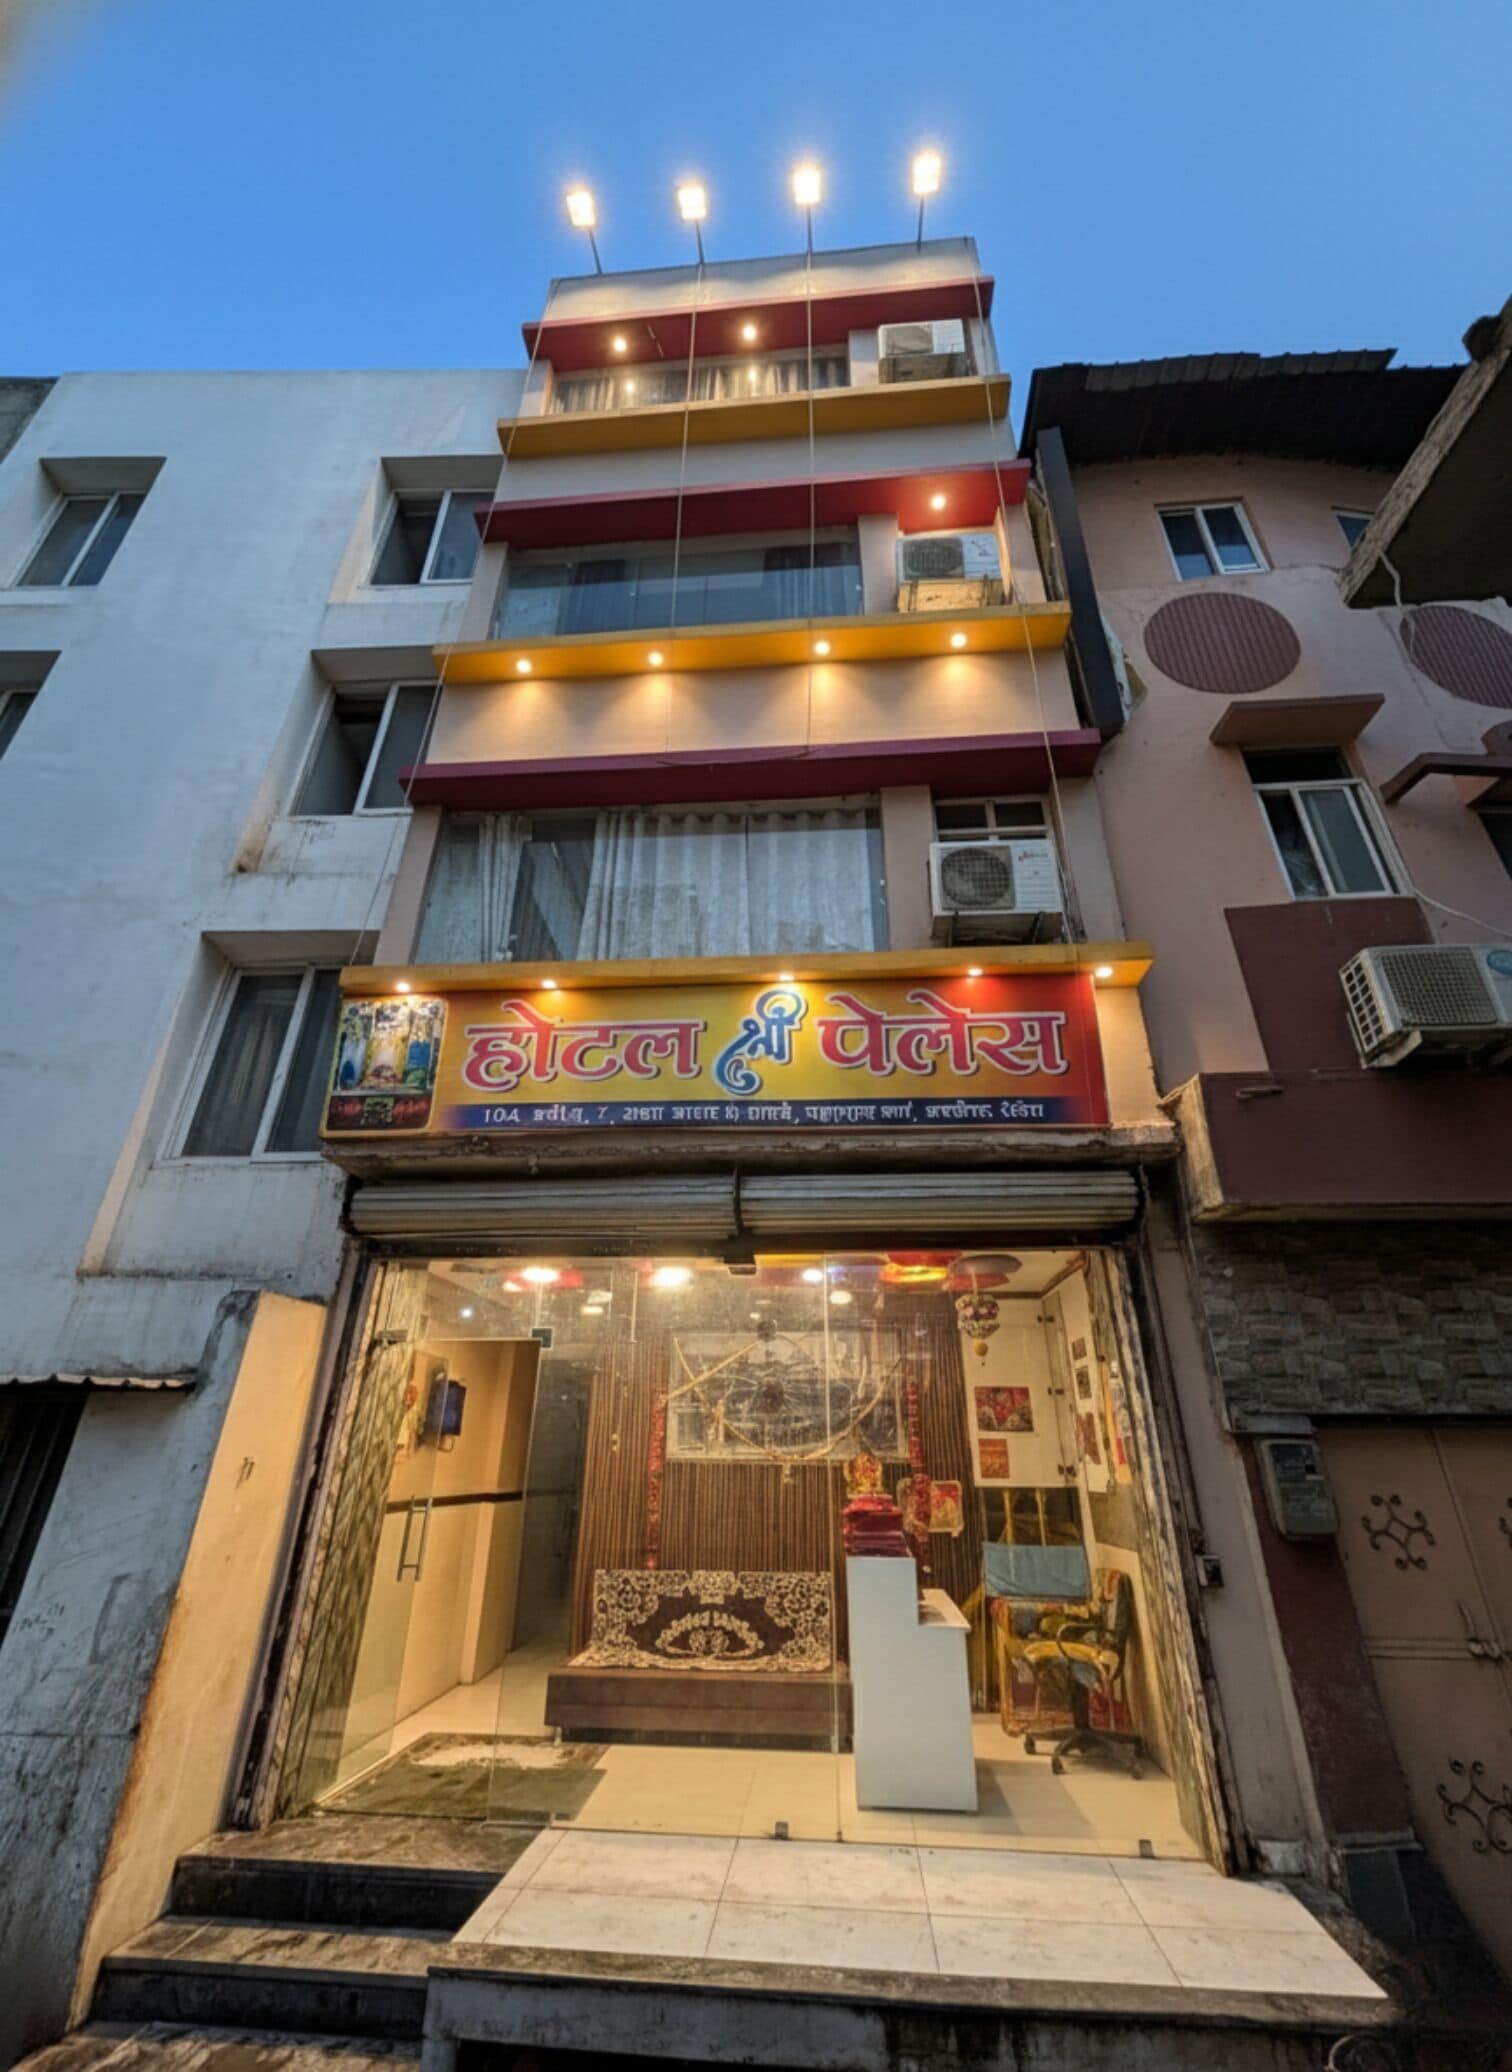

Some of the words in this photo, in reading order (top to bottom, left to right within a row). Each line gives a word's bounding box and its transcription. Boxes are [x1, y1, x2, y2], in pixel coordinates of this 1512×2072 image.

[461, 998, 707, 1093] होटल
[713, 988, 809, 1096] श्री
[815, 988, 1071, 1076] पेलेस
